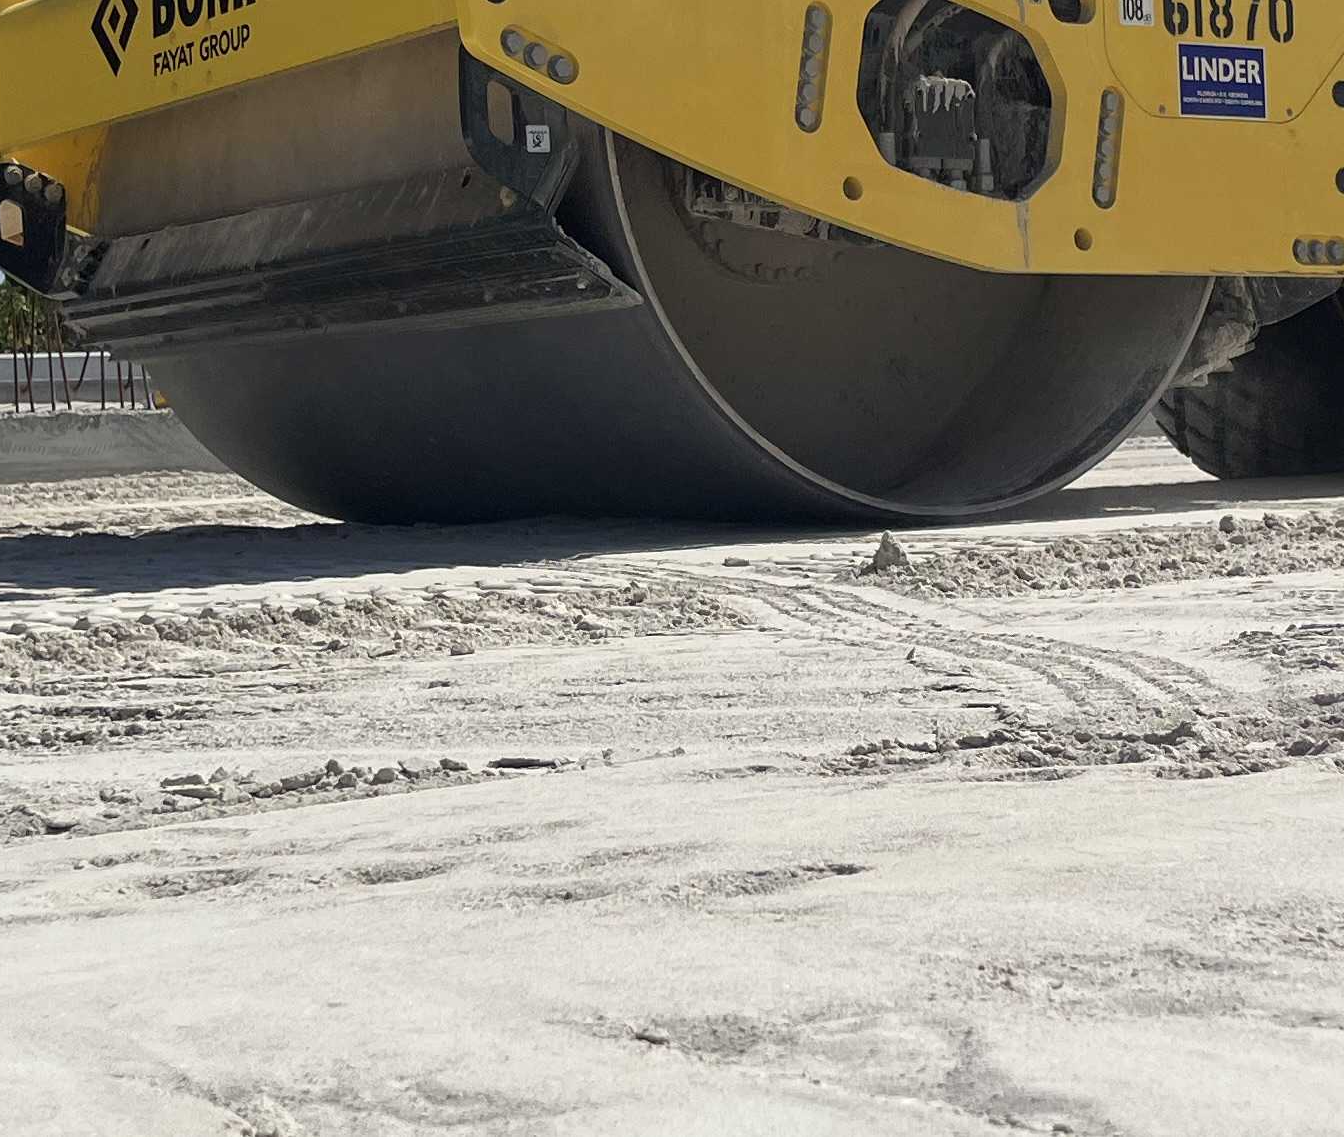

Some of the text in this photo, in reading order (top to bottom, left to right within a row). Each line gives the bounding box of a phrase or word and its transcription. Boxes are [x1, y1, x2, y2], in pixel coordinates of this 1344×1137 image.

[153, 24, 250, 77] FAYAT GROUP
[1181, 55, 1262, 85] LINDER
